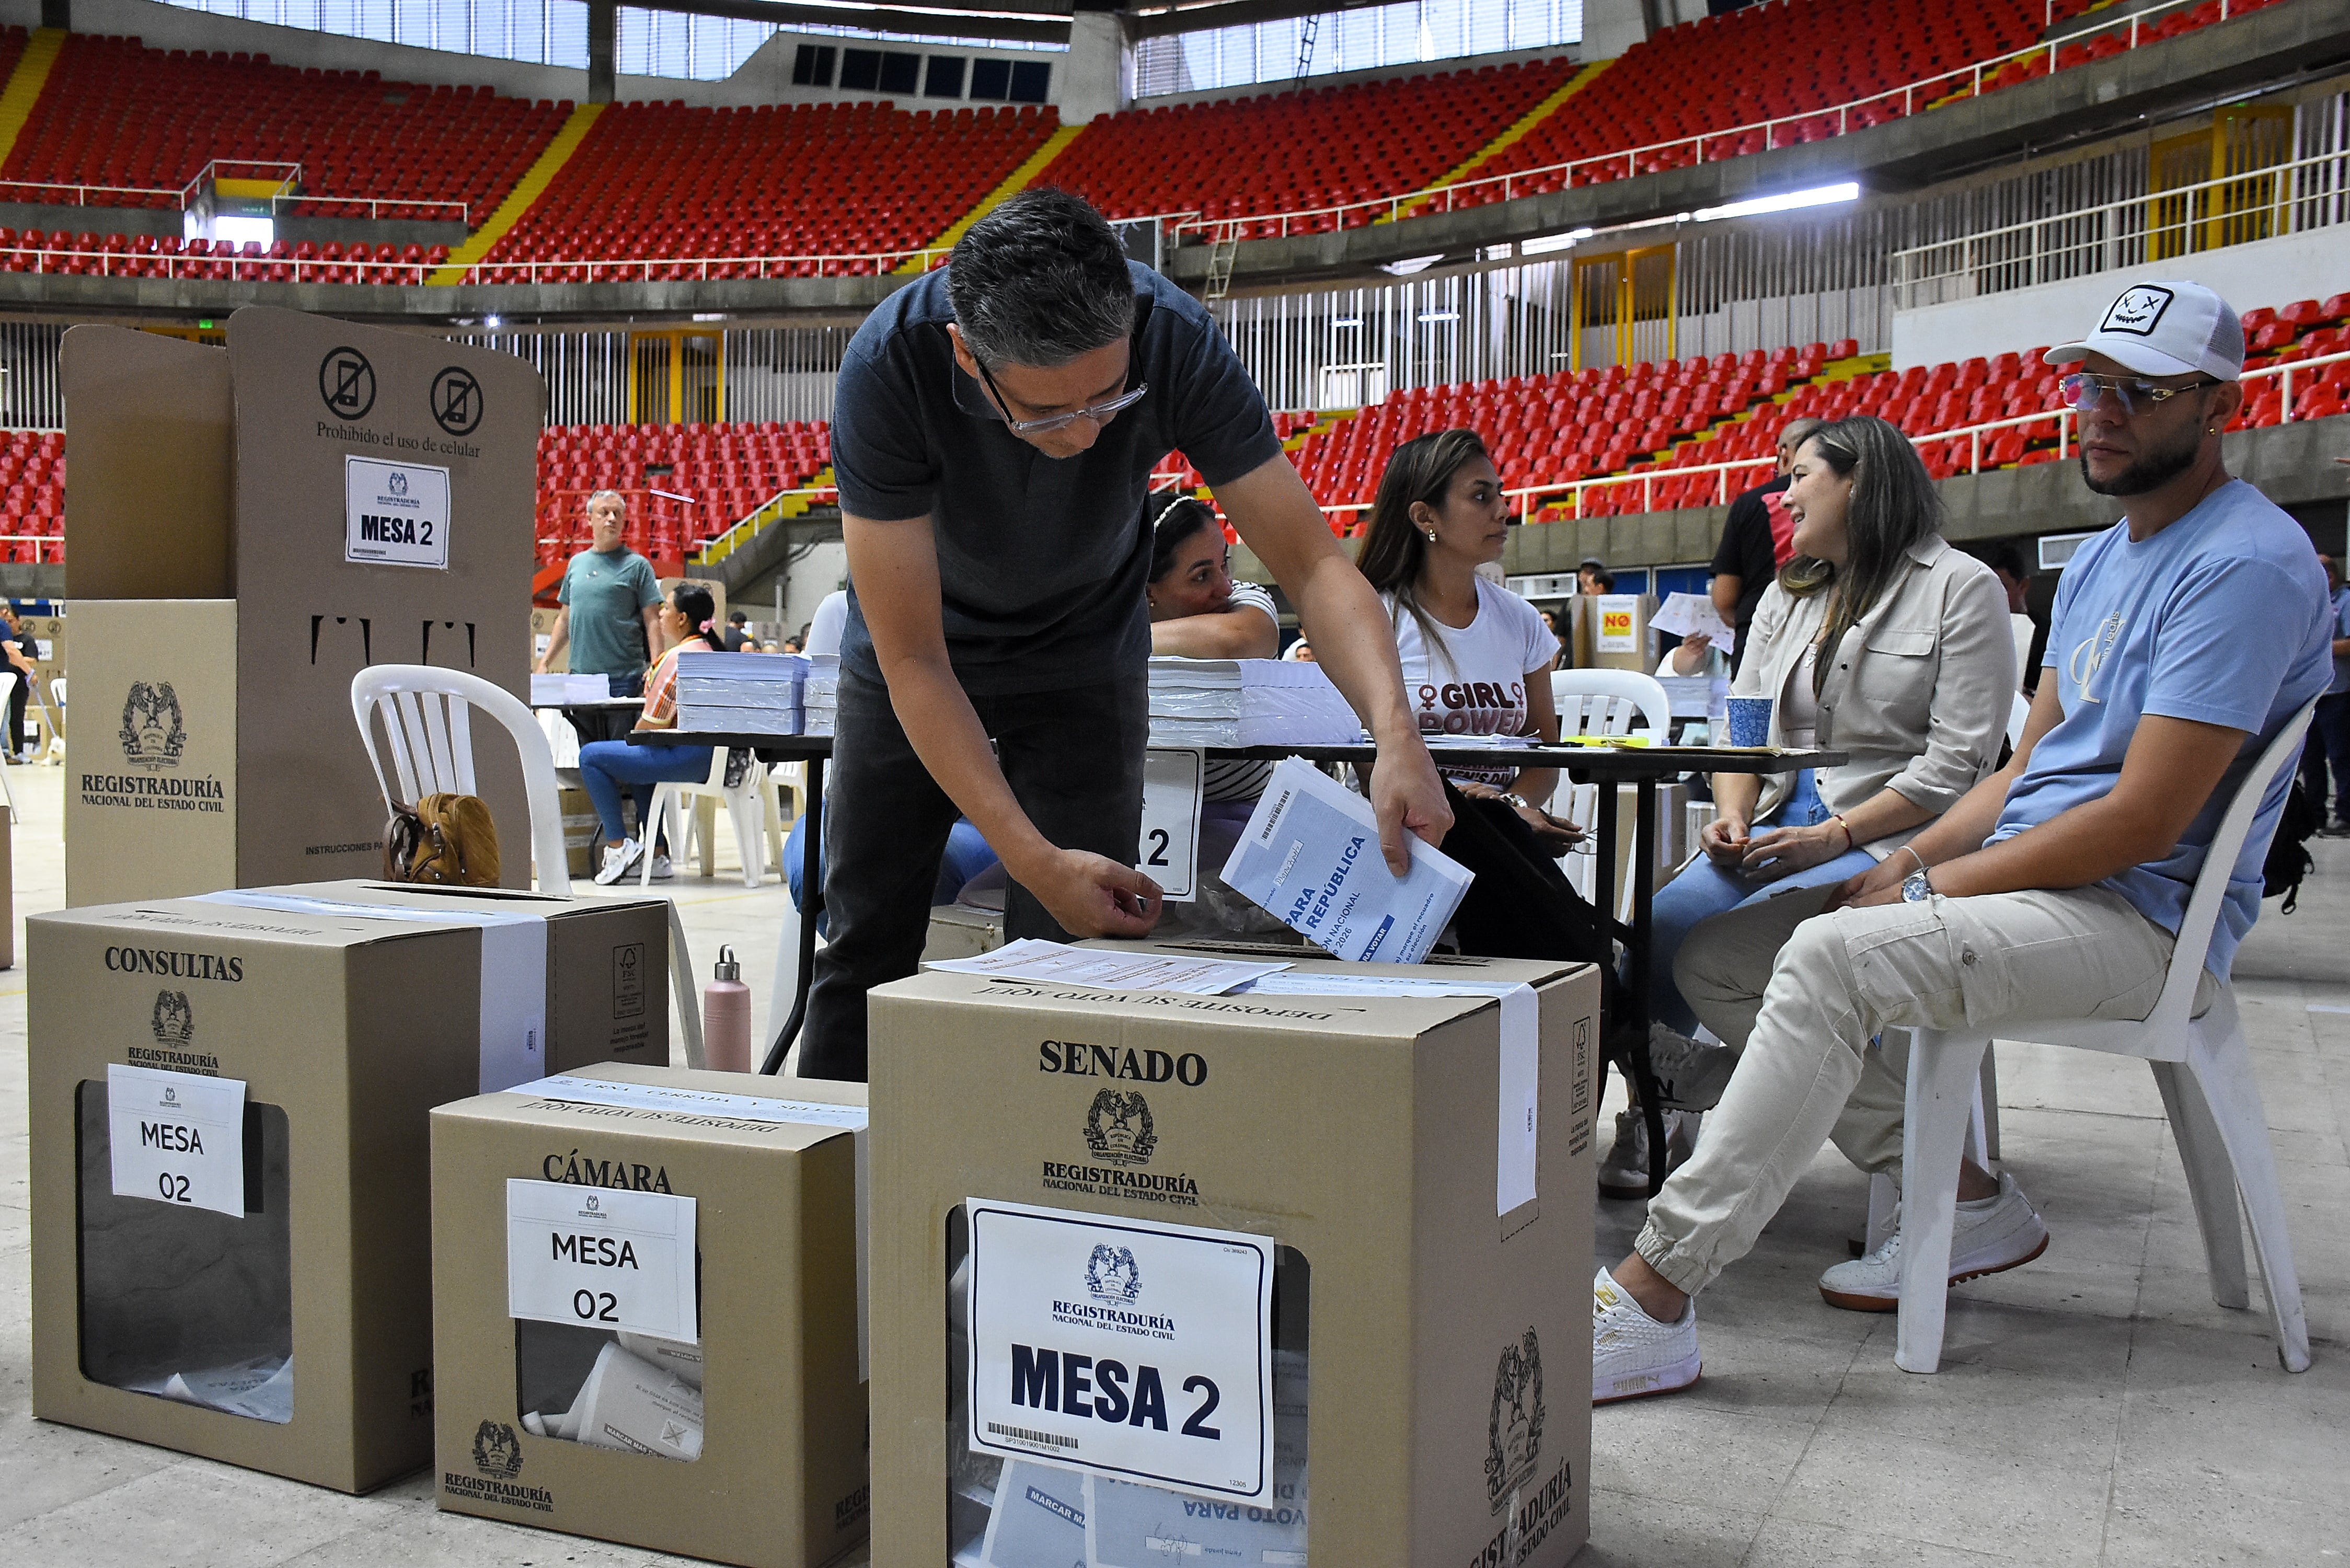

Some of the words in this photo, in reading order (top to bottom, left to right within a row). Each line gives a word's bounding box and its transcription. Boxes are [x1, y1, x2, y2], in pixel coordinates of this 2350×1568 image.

[317, 421, 379, 445] Prohibido
[382, 433, 394, 447] el
[397, 437, 419, 450] uso
[422, 437, 438, 452] de
[440, 444, 481, 458] celular
[361, 515, 416, 545] MESA
[420, 521, 433, 546] 2
[1605, 615, 1630, 627] NO
[2104, 610, 2120, 647] Jeans
[1441, 682, 1516, 710] GIRL
[81, 774, 224, 799] REGISTRADURÍA
[82, 794, 131, 808] NACIONAL
[134, 798, 154, 809] DEL
[157, 799, 195, 811] ESTADO
[198, 801, 224, 813] CIVIL
[305, 843, 372, 855] INSTRUCCIONES
[1147, 828, 1169, 867] 2
[1265, 887, 1276, 903] jurado
[1305, 836, 1366, 929] REPÚBLICA
[1284, 887, 1316, 927] PARA
[1329, 891, 1361, 938] NACIONAL
[1336, 927, 1353, 949] 2026
[1399, 930, 1414, 956] marque
[1416, 892, 1434, 924] recuadro
[1411, 924, 1427, 952] elección
[1369, 927, 1387, 951] VOTAR
[105, 946, 244, 983] CONSULTAS
[972, 987, 1050, 996] AQUÍ
[1053, 992, 1127, 1002] VOTO
[1133, 994, 1178, 1006] SU
[1179, 999, 1333, 1021] DEPOSITE
[128, 1046, 219, 1068] REGISTRADURÍA
[1040, 1040, 1207, 1087] SENADO
[517, 1101, 579, 1111] AQUÍ
[579, 1107, 632, 1117] VOTO
[667, 1112, 781, 1133] DEPOSITE
[141, 1121, 204, 1155] MESA
[543, 1148, 673, 1195] CÁMARA
[1043, 1161, 1199, 1195] REGISTRADURÍA
[159, 1172, 192, 1203] 02
[1043, 1178, 1095, 1193] NACIONAL
[1099, 1186, 1120, 1196] DEL
[1123, 1189, 1166, 1202] ESTADO
[1169, 1194, 1198, 1206] CIVIL
[551, 1232, 639, 1270] MESA
[573, 1289, 619, 1322] 02
[1052, 1300, 1176, 1332] REGISTRADURÍA
[1052, 1313, 1094, 1328] NACIONAL
[1097, 1320, 1114, 1331] DEL
[1115, 1324, 1150, 1336] ESTADO
[1151, 1330, 1176, 1341] CIVIL
[1011, 1343, 1169, 1432] MESA
[1181, 1375, 1221, 1440] 2
[607, 1425, 632, 1446] MARCAR
[1005, 1437, 1060, 1452] SP310019001M1002
[445, 1472, 553, 1504] REGISTRADURÍA
[1229, 1479, 1247, 1488] 12305
[445, 1485, 482, 1499] NACIONAL
[484, 1492, 499, 1502] DEL
[501, 1495, 531, 1507] ESTADO
[533, 1502, 554, 1513] CIVIL
[1031, 1490, 1072, 1518] MARCAR
[1183, 1500, 1239, 1521] PARA
[1247, 1507, 1306, 1525] VOTO
[1517, 1520, 1549, 1567] ESTADO
[1550, 1496, 1570, 1531] CIVIL
